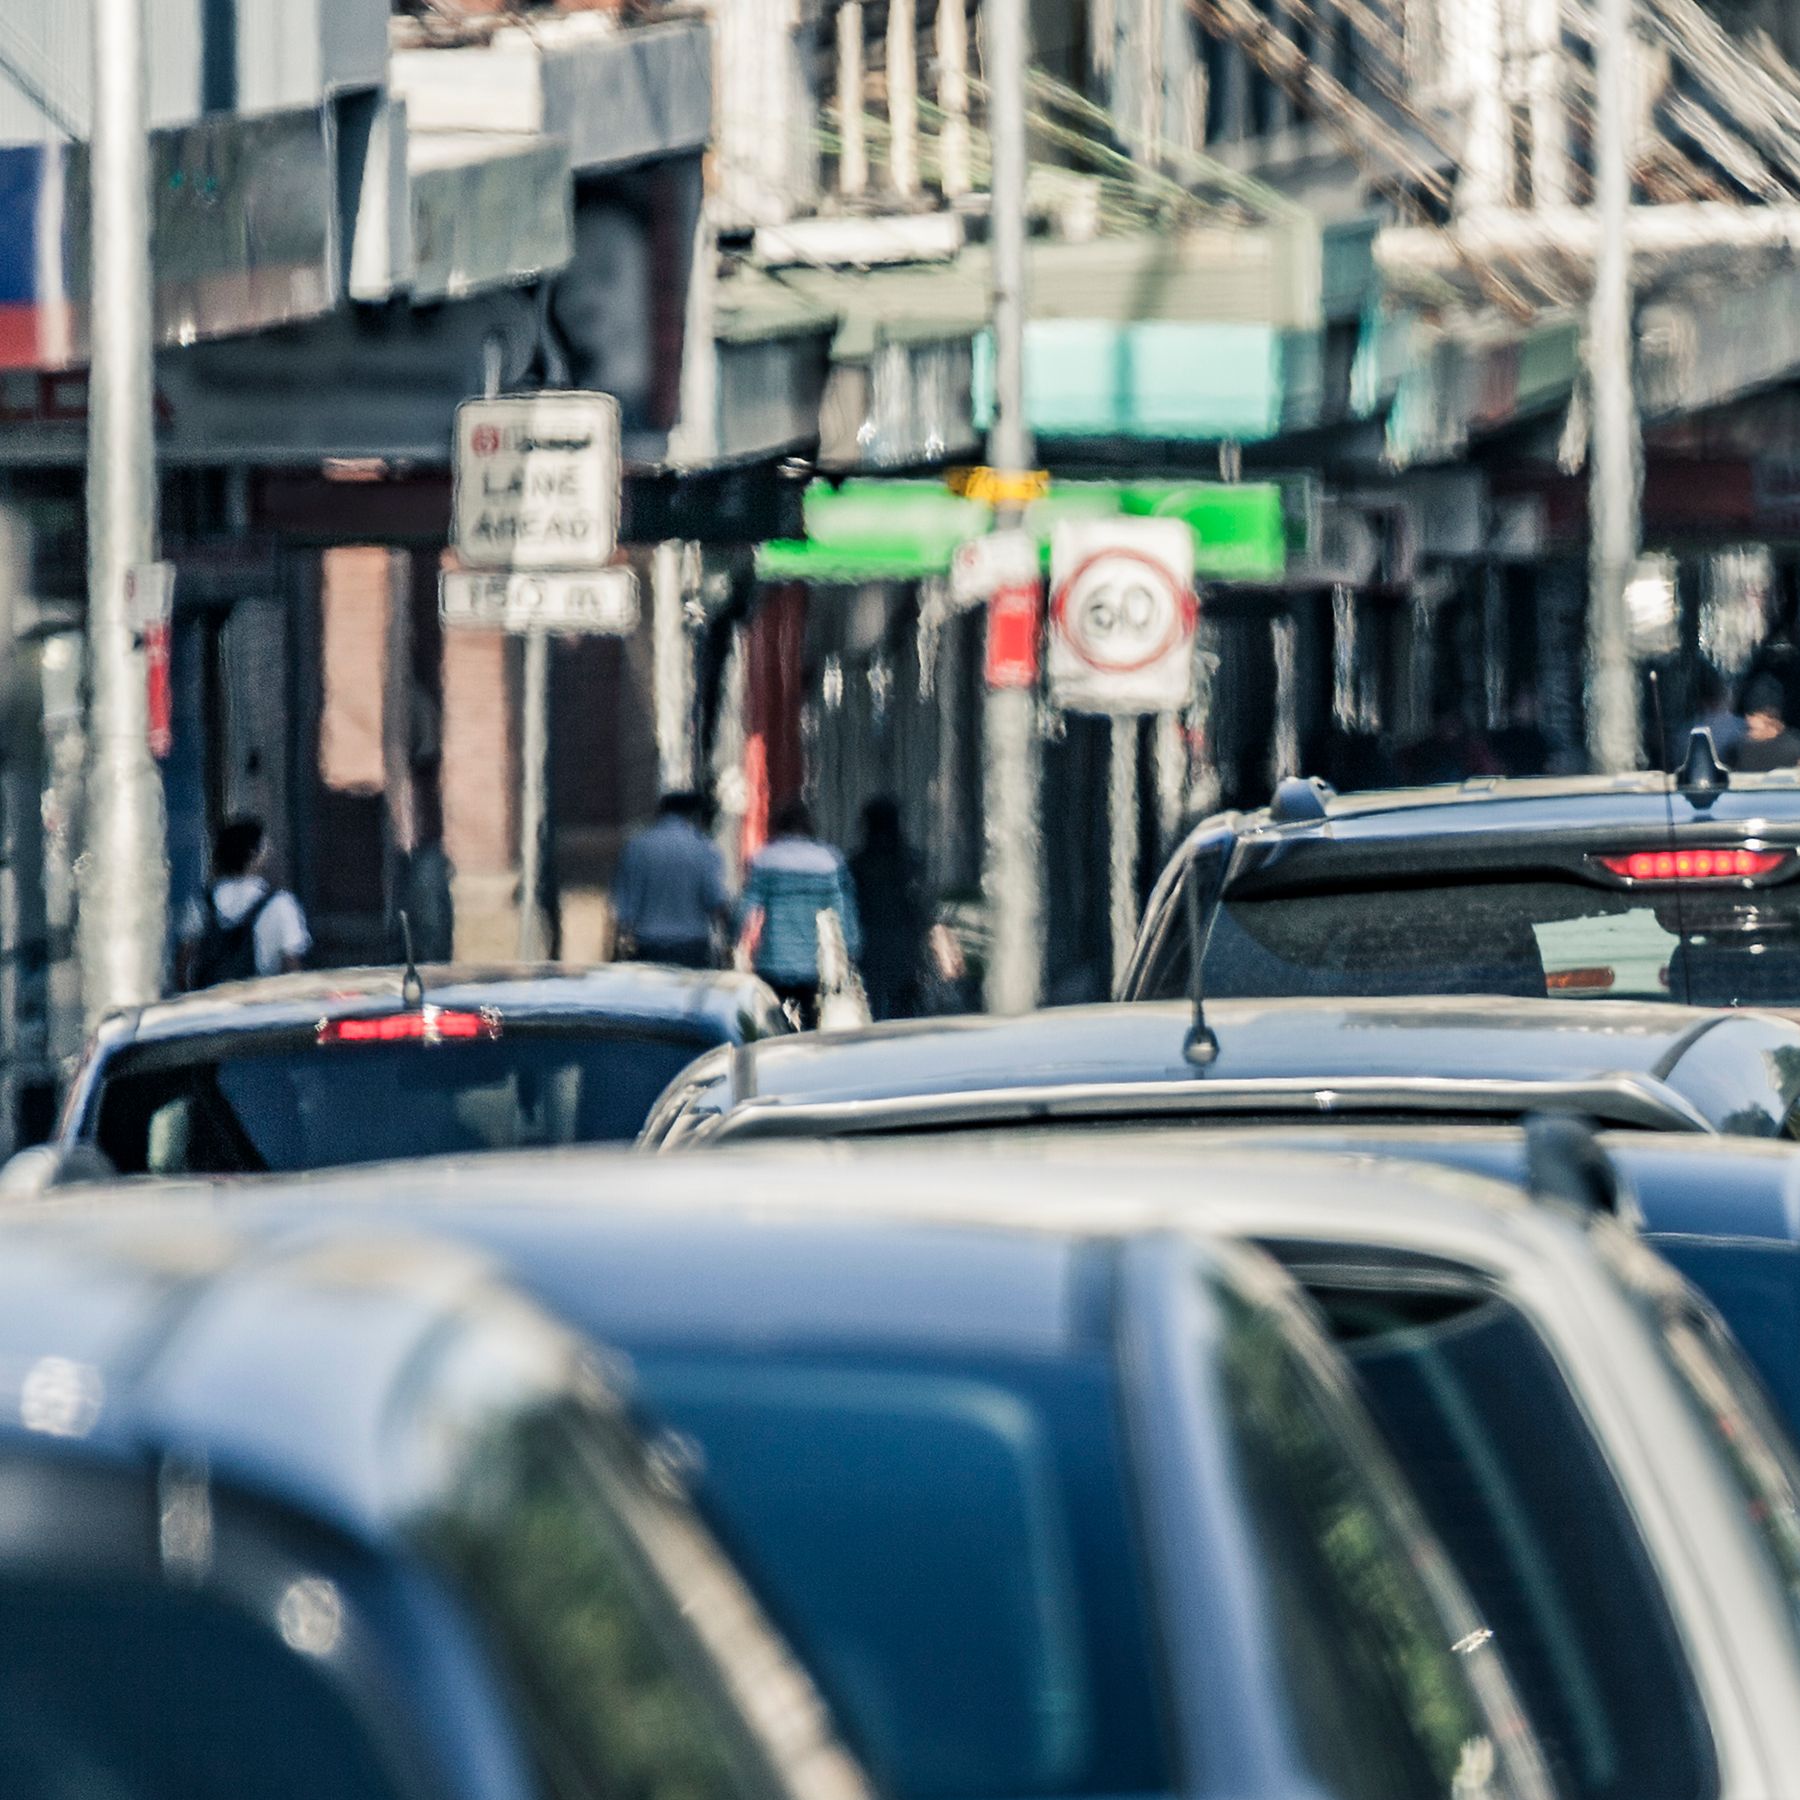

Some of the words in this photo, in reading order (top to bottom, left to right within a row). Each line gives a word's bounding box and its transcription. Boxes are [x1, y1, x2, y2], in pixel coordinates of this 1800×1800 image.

[482, 466, 578, 498] LANE
[472, 511, 590, 542] AHEAD
[469, 577, 543, 610] 150
[1079, 582, 1156, 641] 60
